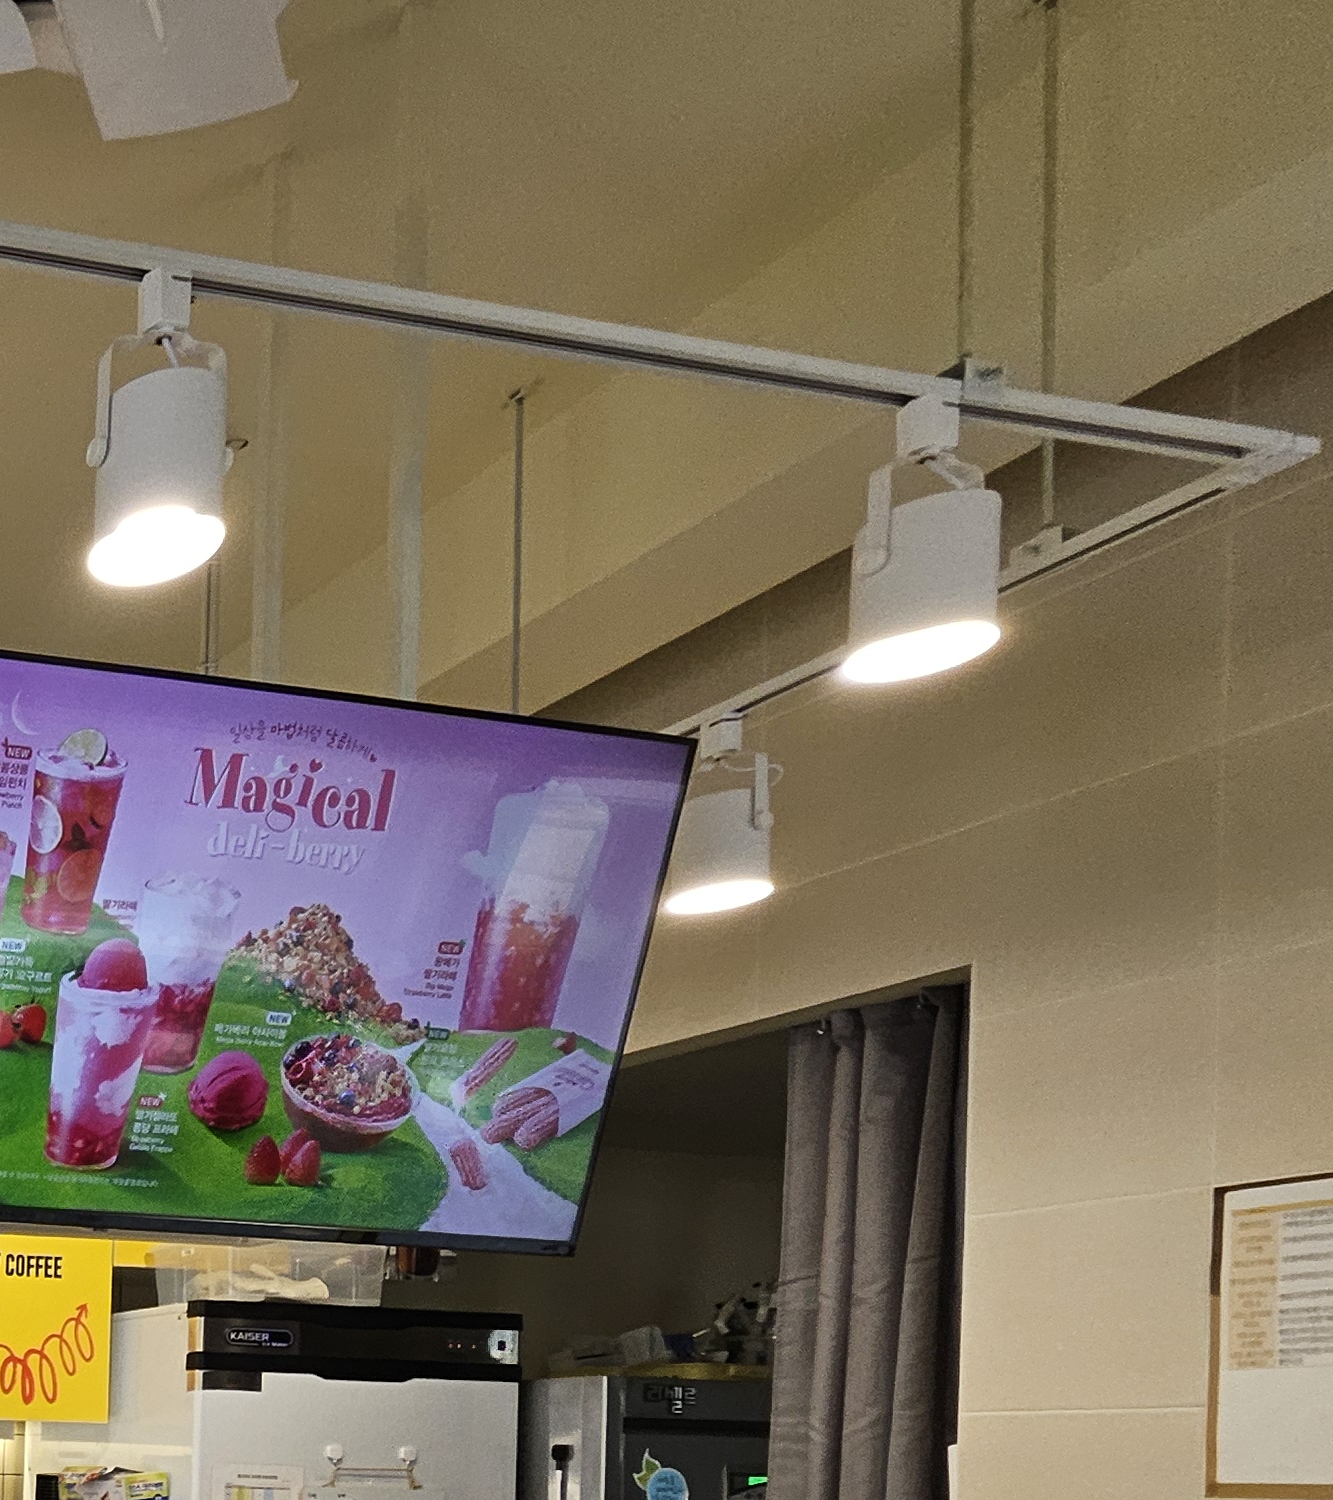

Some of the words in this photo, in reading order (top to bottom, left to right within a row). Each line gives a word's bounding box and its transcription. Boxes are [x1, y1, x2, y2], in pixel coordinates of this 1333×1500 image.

[6, 747, 31, 758] NEW
[184, 747, 396, 832] Magical
[5, 1254, 64, 1279] COFFEE
[230, 1332, 270, 1341] KAISER
